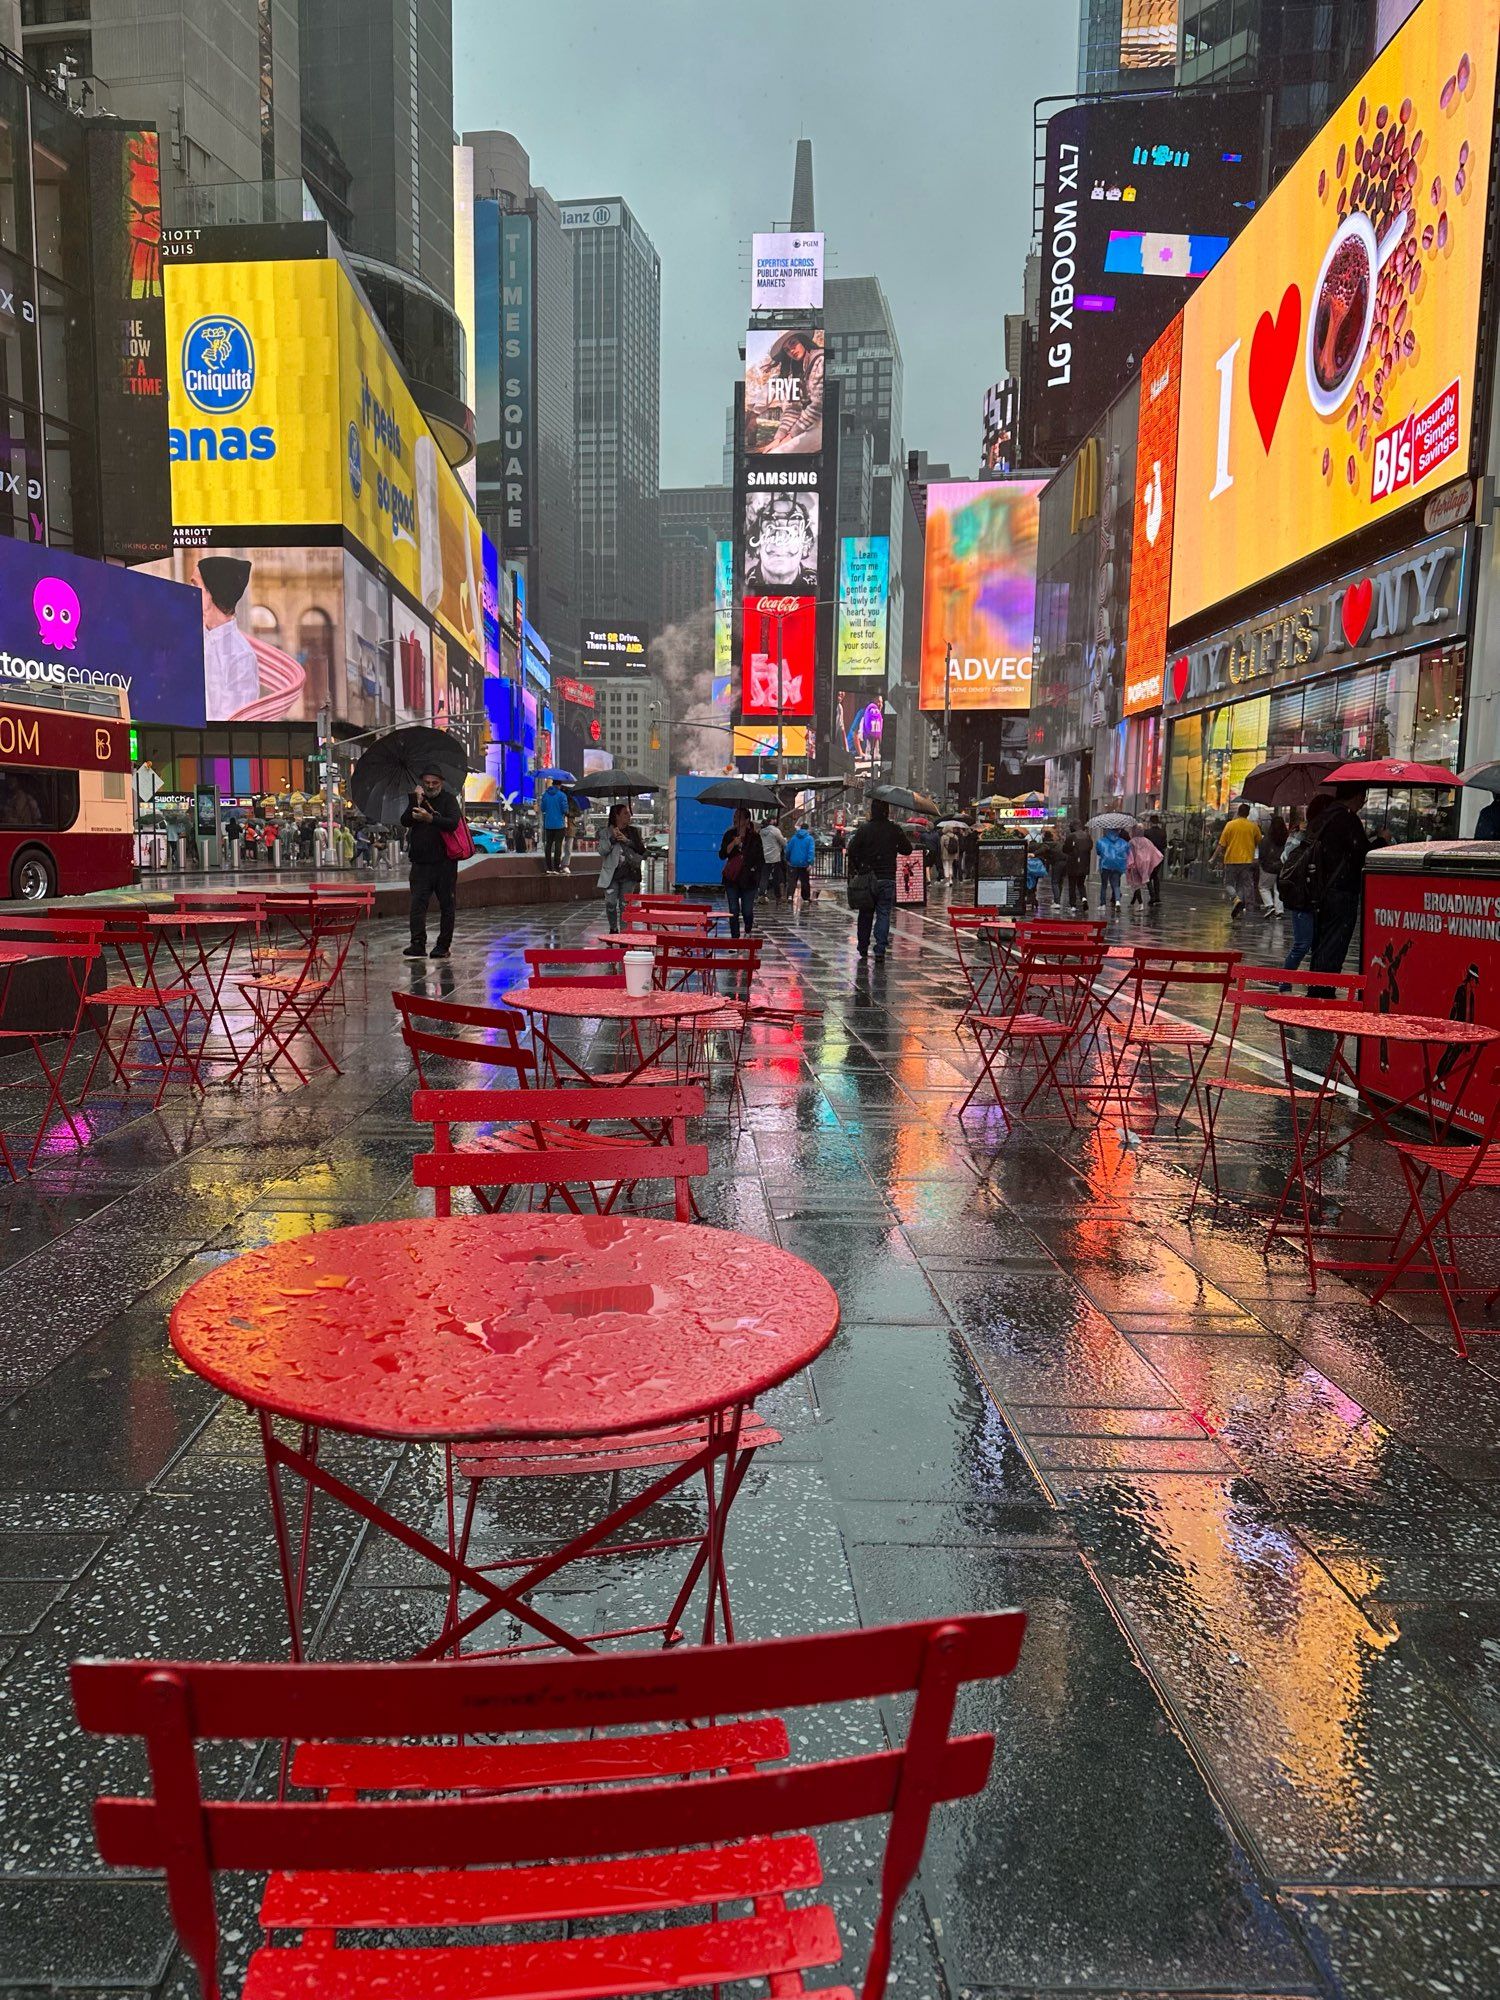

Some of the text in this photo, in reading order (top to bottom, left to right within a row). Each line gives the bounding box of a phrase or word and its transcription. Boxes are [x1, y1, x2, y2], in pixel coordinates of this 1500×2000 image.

[802, 240, 819, 248] PGIM
[757, 258, 815, 268] EXPERTISE ACROSS
[1048, 143, 1079, 387] LG XBOOM XL7
[757, 268, 818, 278] PUBLIC AND PRIVATE
[757, 278, 786, 288] MARKETS
[185, 368, 252, 397] Chiquita
[503, 233, 523, 528] TIMES SQUARE
[767, 377, 801, 401] FRYE
[1415, 393, 1456, 440] Absurdly
[373, 398, 401, 460] peels
[1423, 413, 1456, 450] Simple
[747, 471, 818, 486] SAMSUNG
[376, 470, 390, 514] so
[391, 483, 415, 536] good
[173, 528, 213, 536] ARRIOTT
[173, 537, 207, 545] ARQUIS
[851, 562, 867, 570] from
[851, 573, 862, 582] for
[846, 584, 882, 596] gentle and
[757, 595, 800, 612] Coca-Cola
[851, 595, 877, 606] lowly of
[867, 609, 880, 617] you
[849, 617, 877, 627] will find
[589, 631, 607, 641] Text
[850, 630, 875, 639] rest for
[585, 640, 607, 650] There
[615, 642, 626, 651] No
[843, 642, 859, 652] your
[1229, 604, 1319, 685] GIFTS
[0, 651, 66, 684] topus
[154, 795, 186, 803] swatch
[1423, 892, 1500, 918] BROADWAY'S
[1374, 908, 1401, 928] TONY
